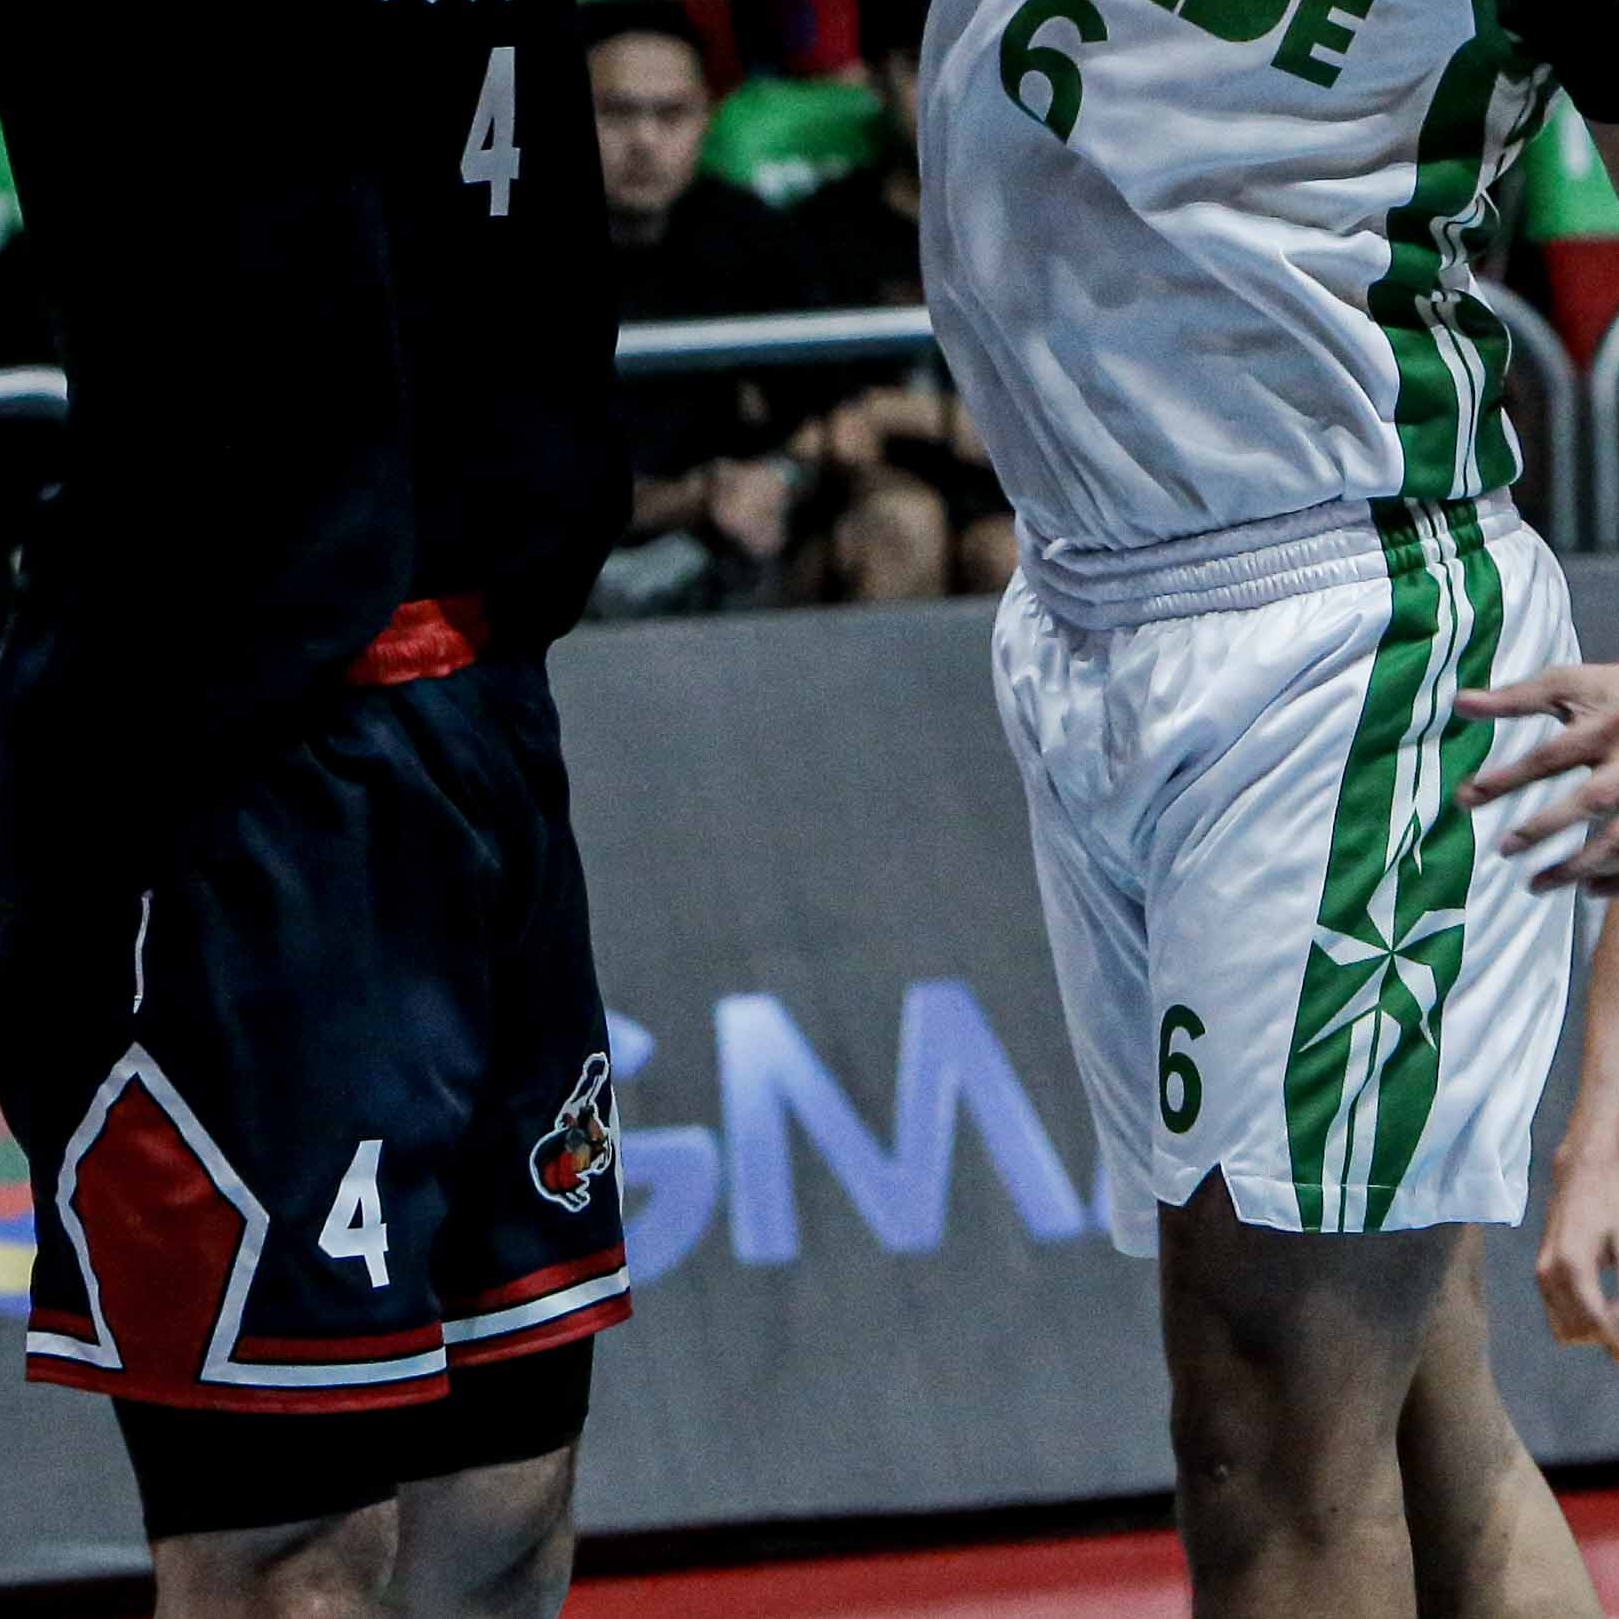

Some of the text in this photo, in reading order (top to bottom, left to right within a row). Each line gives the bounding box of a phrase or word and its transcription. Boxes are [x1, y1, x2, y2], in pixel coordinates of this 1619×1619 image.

[459, 46, 522, 217] 4
[1159, 1004, 1205, 1135] 6
[318, 1139, 390, 1288] 4
